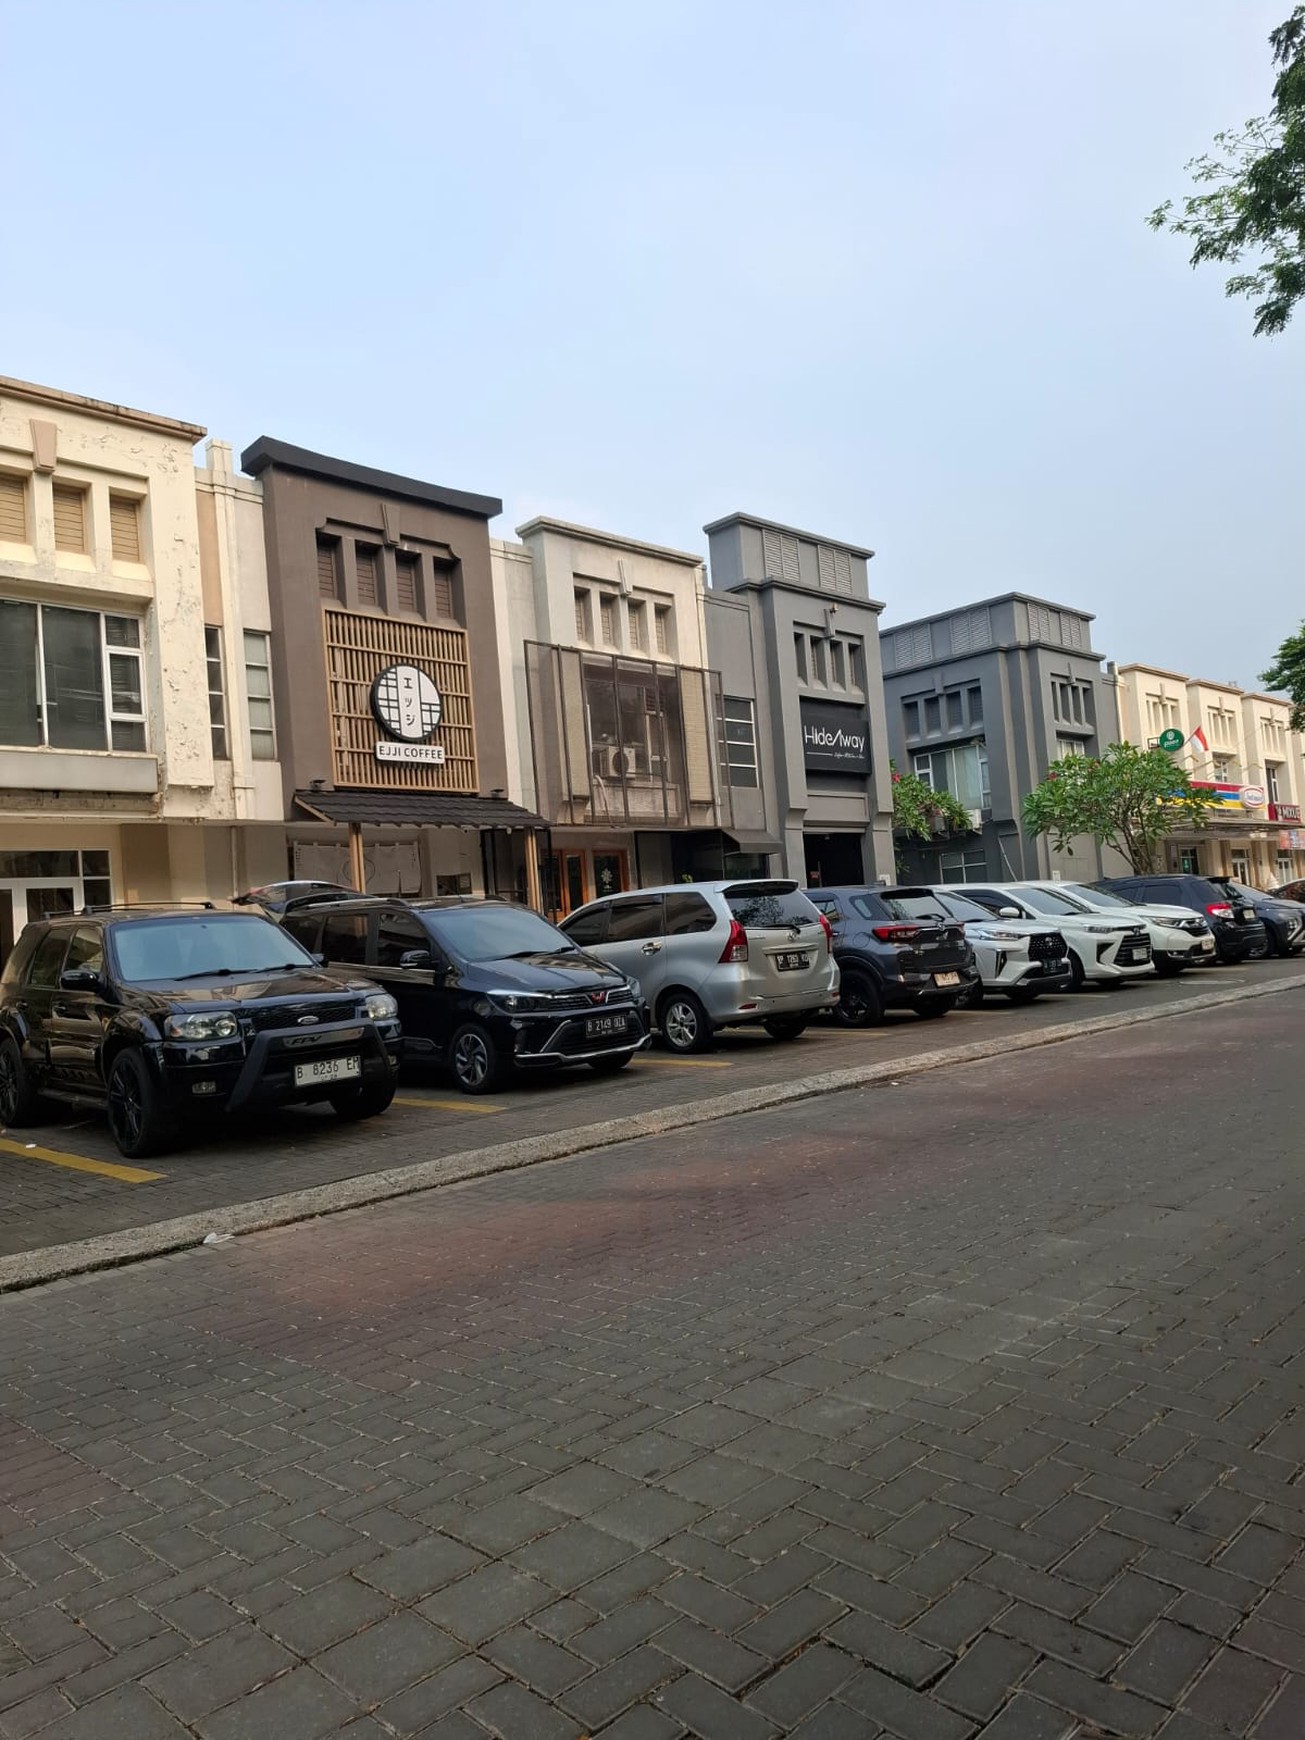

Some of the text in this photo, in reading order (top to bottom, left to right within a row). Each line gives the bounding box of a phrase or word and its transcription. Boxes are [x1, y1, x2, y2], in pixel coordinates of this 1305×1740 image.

[379, 745, 443, 760] EJJI COFFEE
[297, 1067, 303, 1079] B
[312, 1060, 339, 1076] 8236
